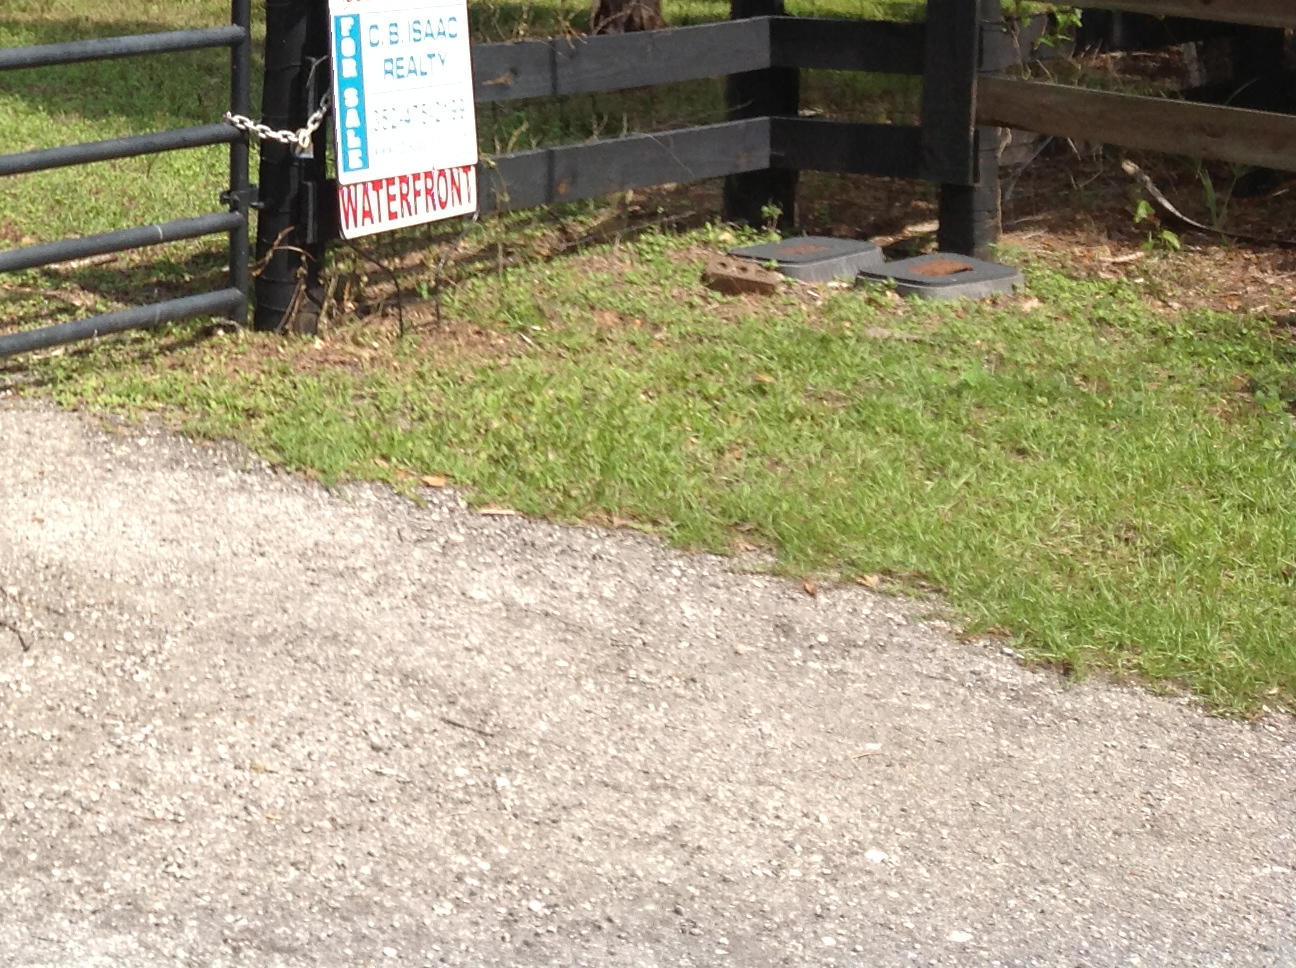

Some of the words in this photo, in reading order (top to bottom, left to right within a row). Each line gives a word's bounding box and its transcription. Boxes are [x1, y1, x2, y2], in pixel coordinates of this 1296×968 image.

[340, 16, 357, 79] FOR
[408, 16, 458, 43] ISAAC
[383, 51, 448, 80] REALTY
[343, 87, 364, 170] SALE
[338, 165, 472, 230] WATERFRONT
